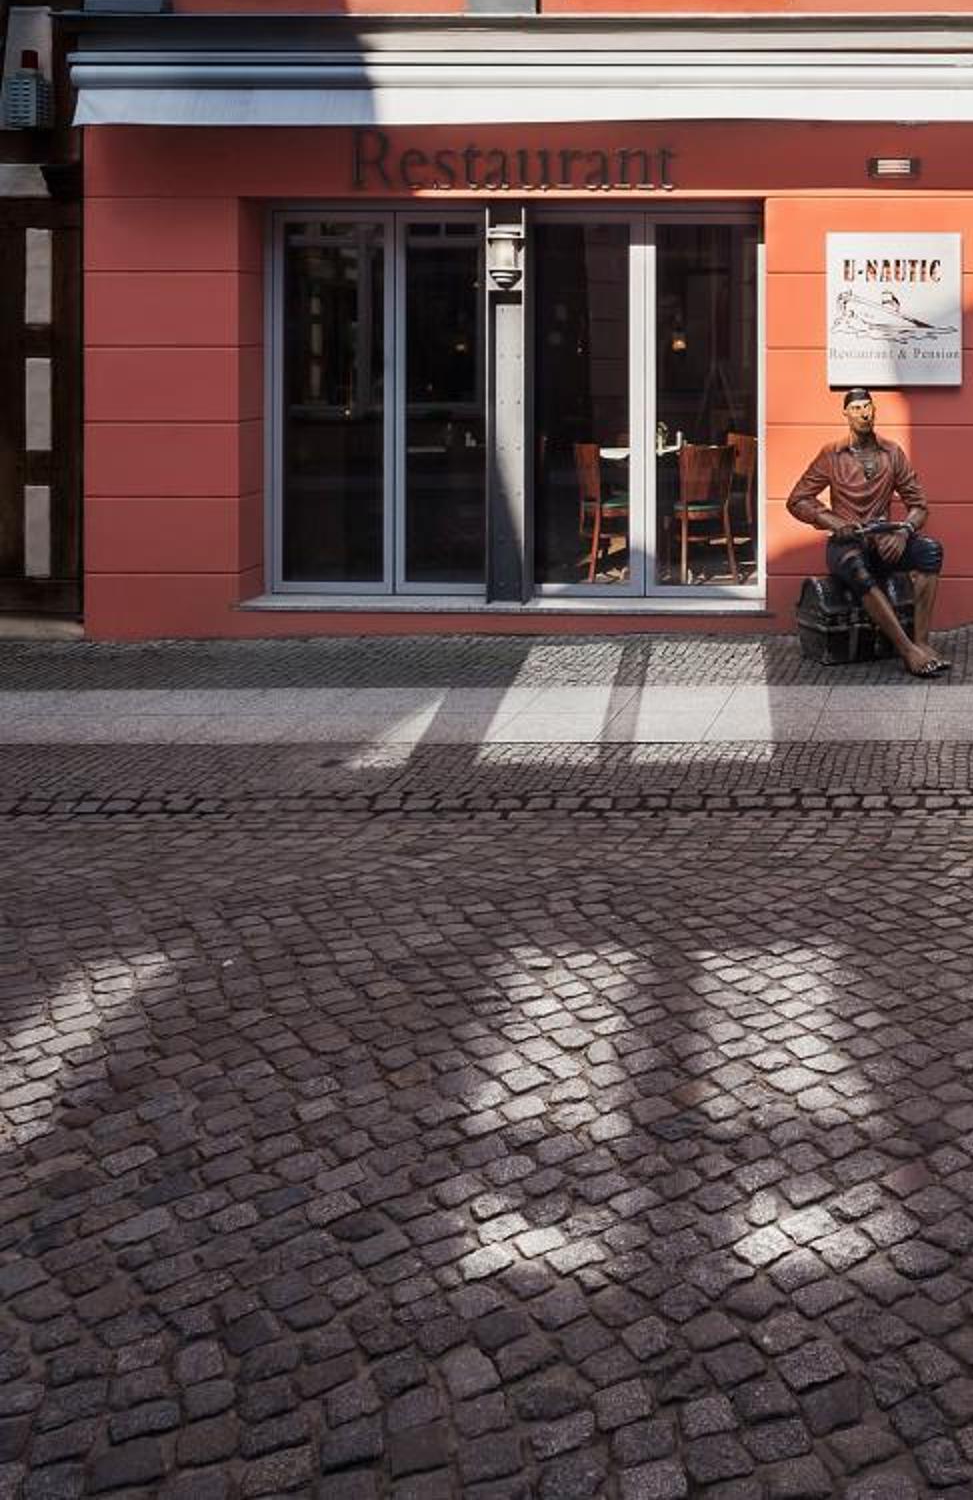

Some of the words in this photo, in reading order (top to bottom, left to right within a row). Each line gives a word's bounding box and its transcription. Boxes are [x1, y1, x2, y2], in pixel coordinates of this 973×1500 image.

[351, 129, 676, 189] Restaurant
[843, 259, 941, 282] U-NAUTIC
[913, 348, 960, 359] Pension
